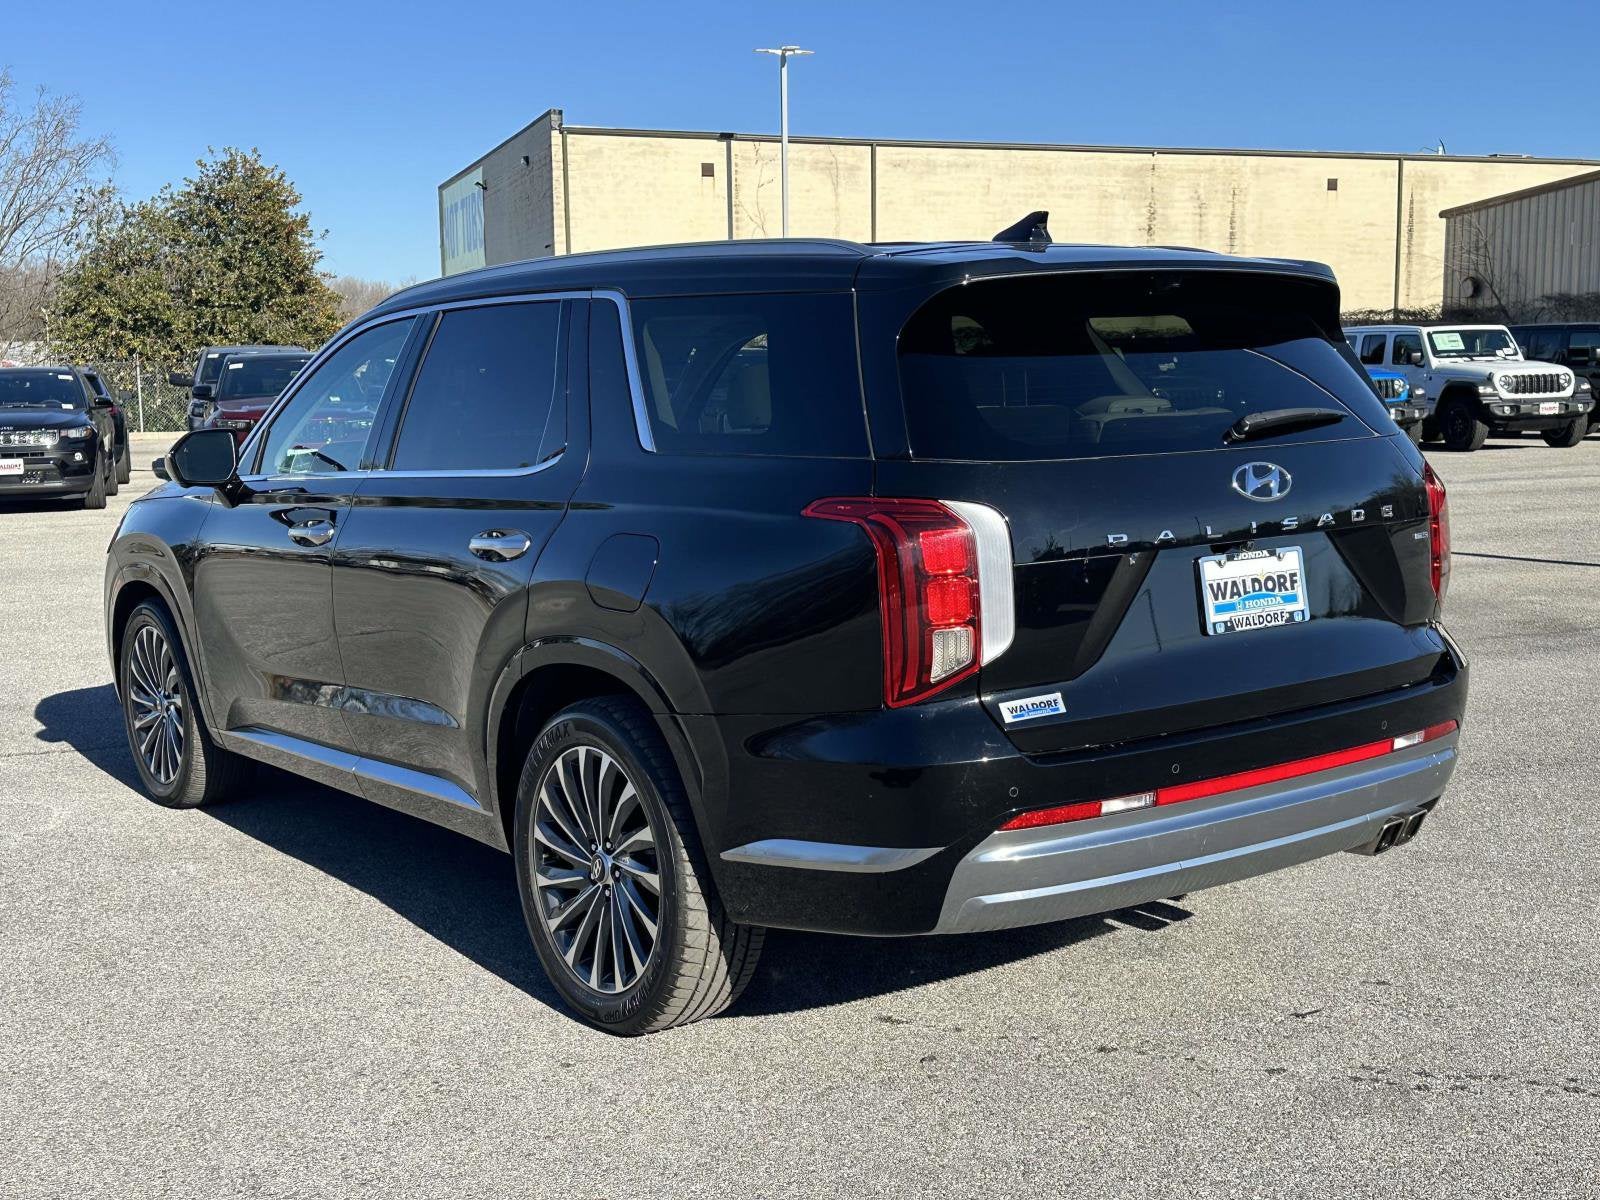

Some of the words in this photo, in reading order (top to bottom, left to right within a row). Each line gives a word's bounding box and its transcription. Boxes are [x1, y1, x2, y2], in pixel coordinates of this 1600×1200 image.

[1107, 504, 1394, 547] PALISADE
[1233, 549, 1270, 561] HONDA
[1208, 572, 1298, 601] WALDORF
[1245, 596, 1284, 609] HONDA
[1233, 611, 1286, 629] WALDORF
[1007, 699, 1059, 714] WALDORF
